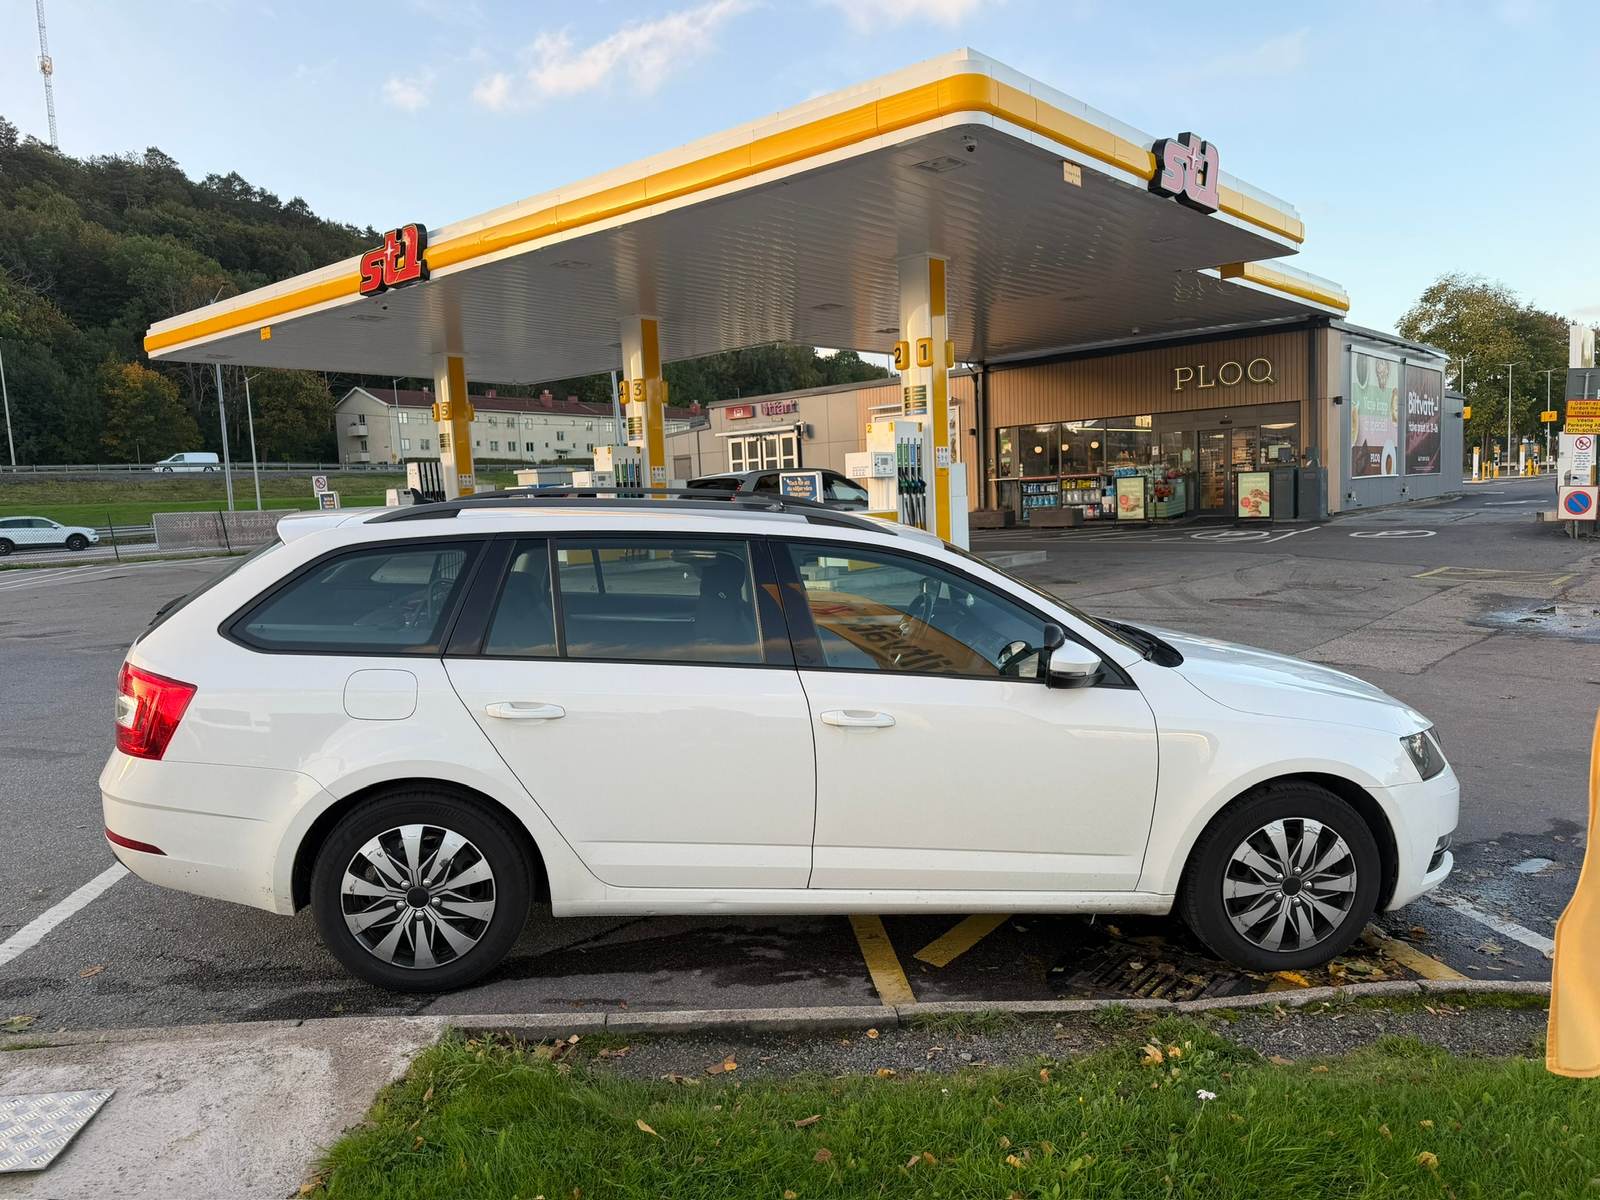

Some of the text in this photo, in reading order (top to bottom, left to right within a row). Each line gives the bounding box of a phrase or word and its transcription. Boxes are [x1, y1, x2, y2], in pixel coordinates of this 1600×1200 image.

[894, 347, 902, 364] 2
[920, 343, 927, 361] 1
[1174, 358, 1274, 391] PLOQ
[634, 382, 642, 397] 3
[441, 405, 448, 416] 5
[1408, 391, 1435, 416] Biltvätt
